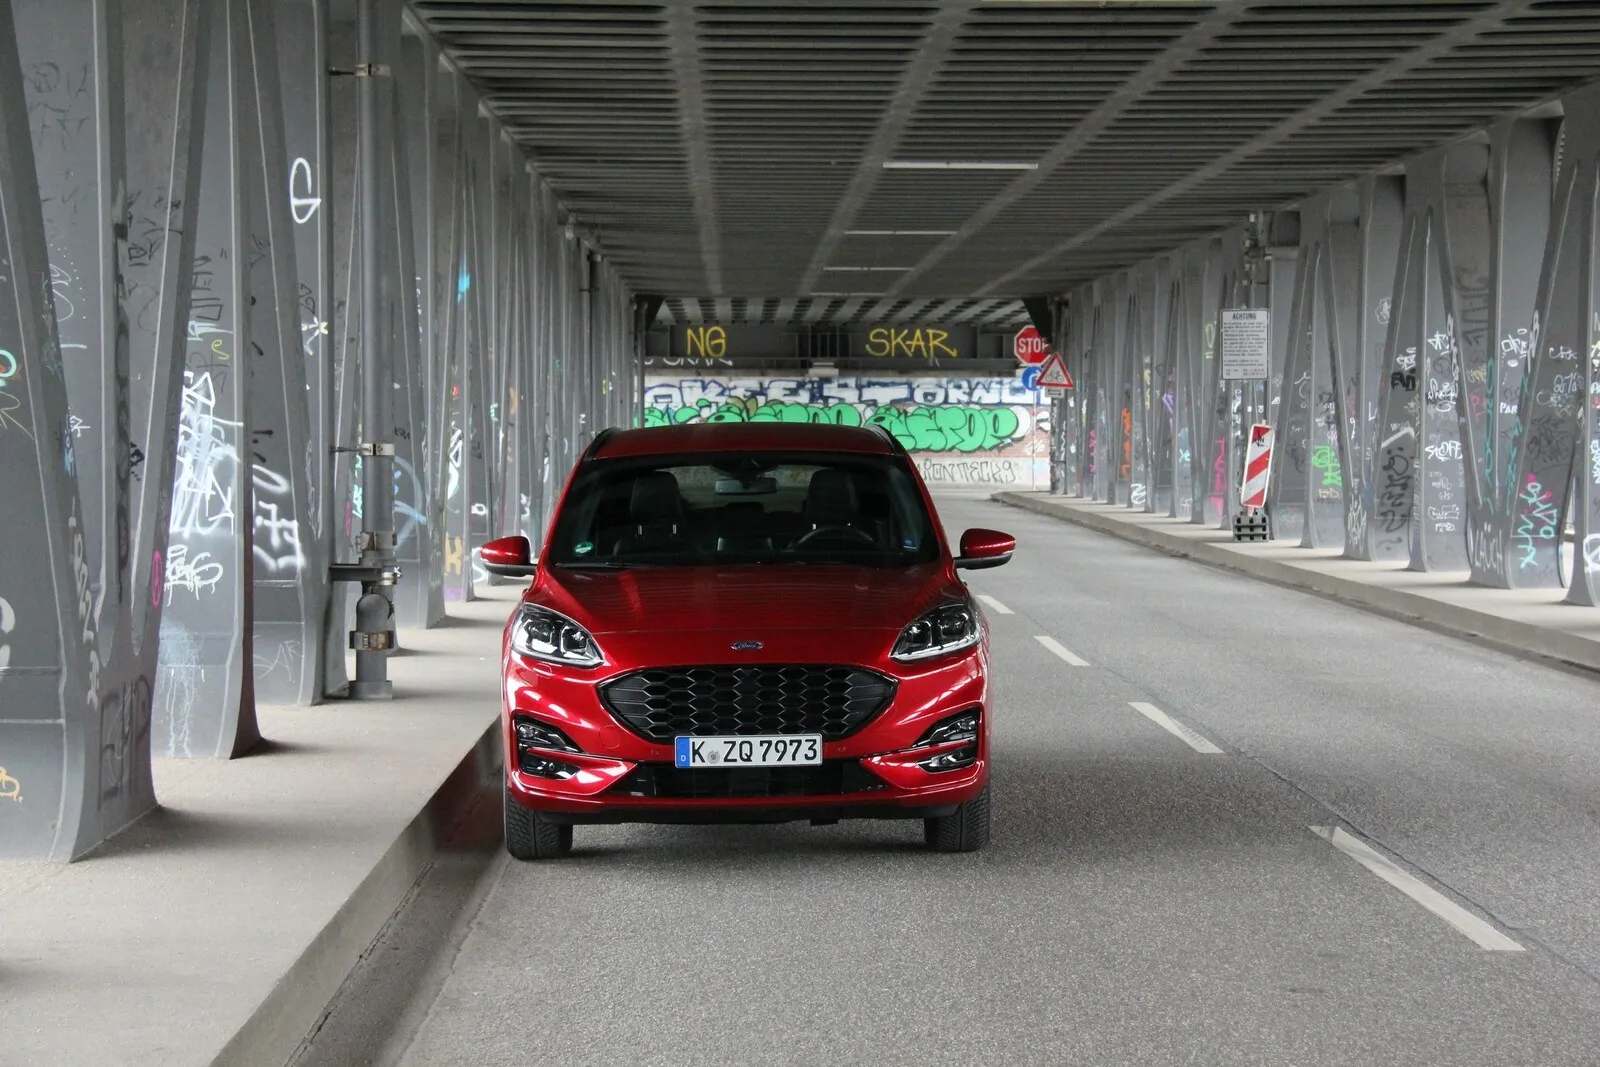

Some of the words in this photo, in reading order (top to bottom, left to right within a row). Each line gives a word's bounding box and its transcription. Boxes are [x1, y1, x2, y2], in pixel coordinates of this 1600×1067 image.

[1232, 312, 1257, 320] ACHTUNG
[686, 326, 727, 357] NG
[865, 328, 958, 358] SKAR
[680, 754, 687, 762] D
[692, 740, 706, 763] K
[723, 740, 753, 763] ZQ
[759, 738, 817, 762] 7973
